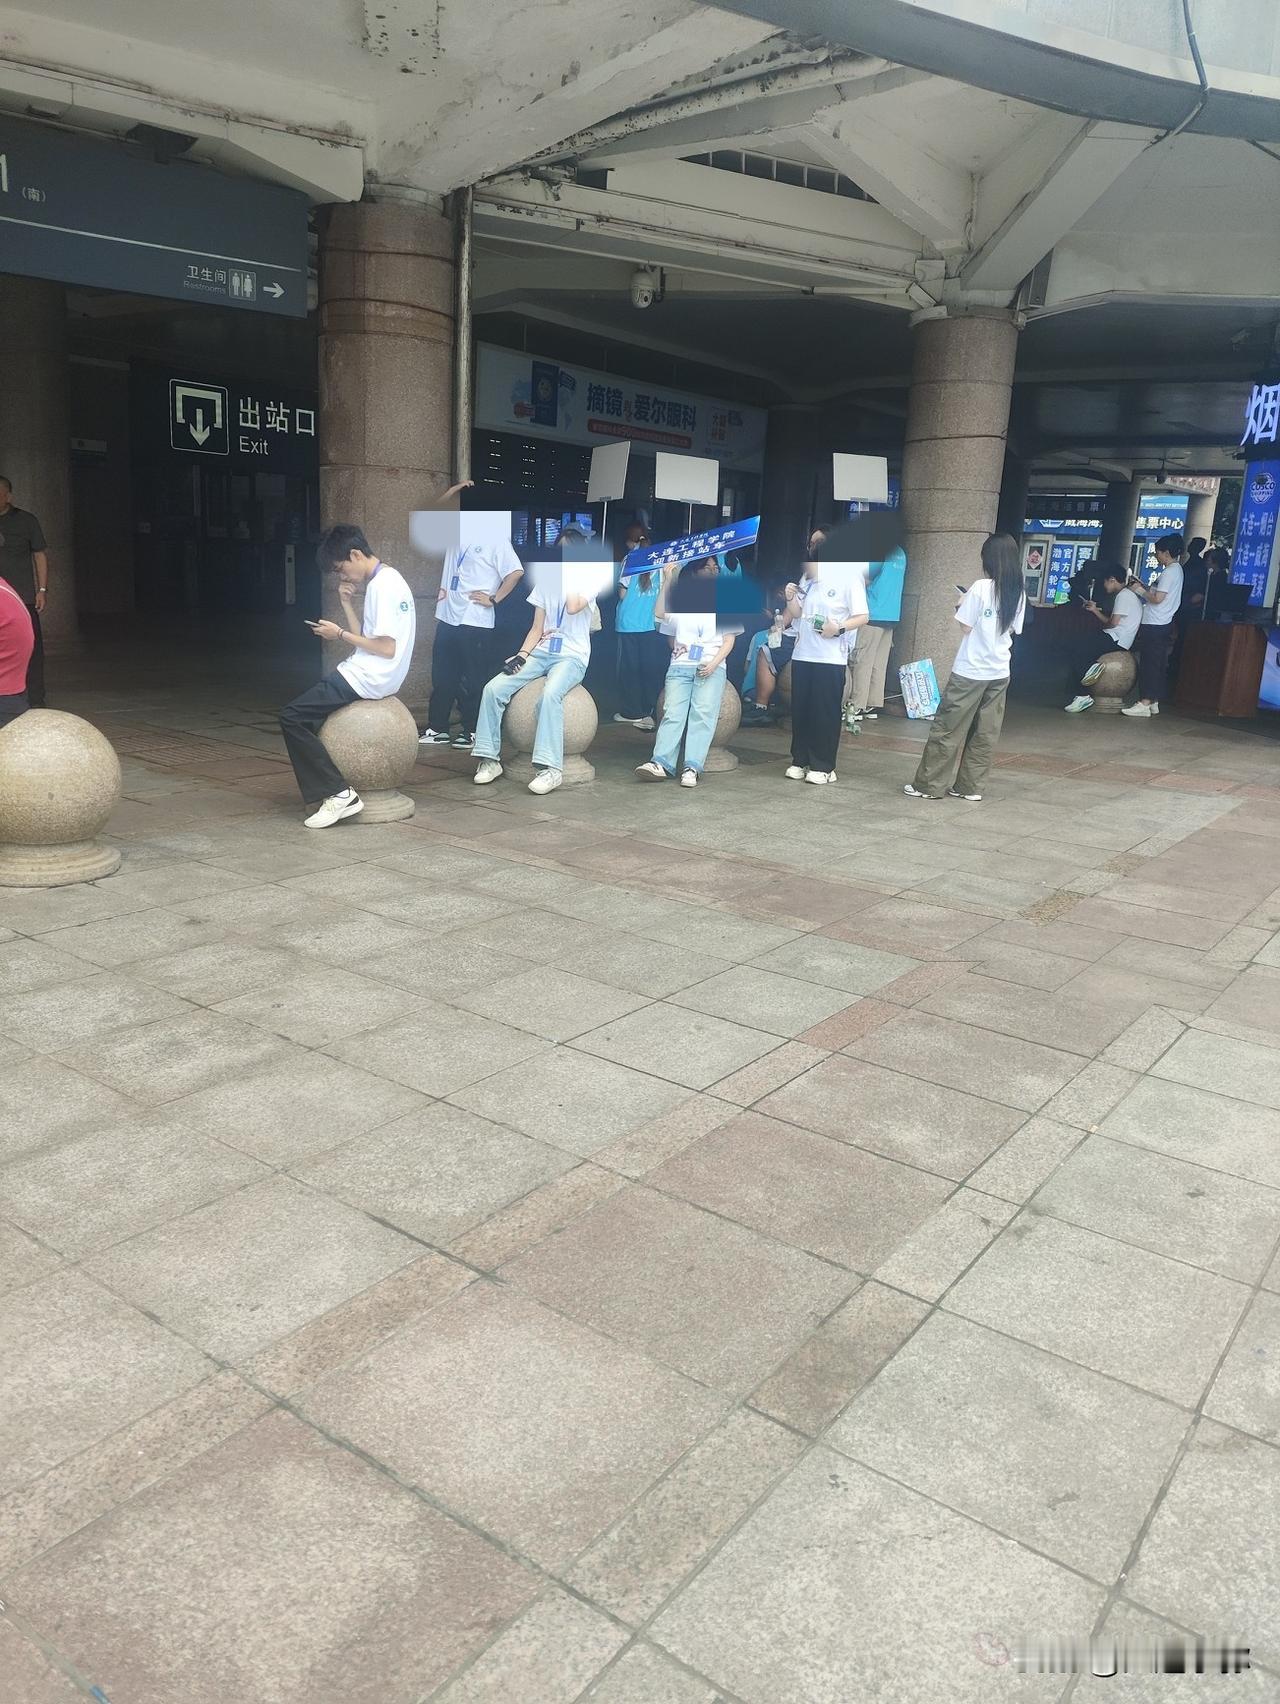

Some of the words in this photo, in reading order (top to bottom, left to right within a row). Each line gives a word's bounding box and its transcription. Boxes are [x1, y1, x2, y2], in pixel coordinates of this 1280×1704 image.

[186, 265, 227, 285] 卫生间
[183, 280, 227, 295] Restrooms
[239, 396, 316, 437] 出站口
[1240, 383, 1280, 447] 烟
[239, 435, 269, 456] Exit
[1064, 518, 1104, 529] 威海海
[1136, 516, 1185, 530] 售票中心
[647, 529, 736, 561] 大连工程学院
